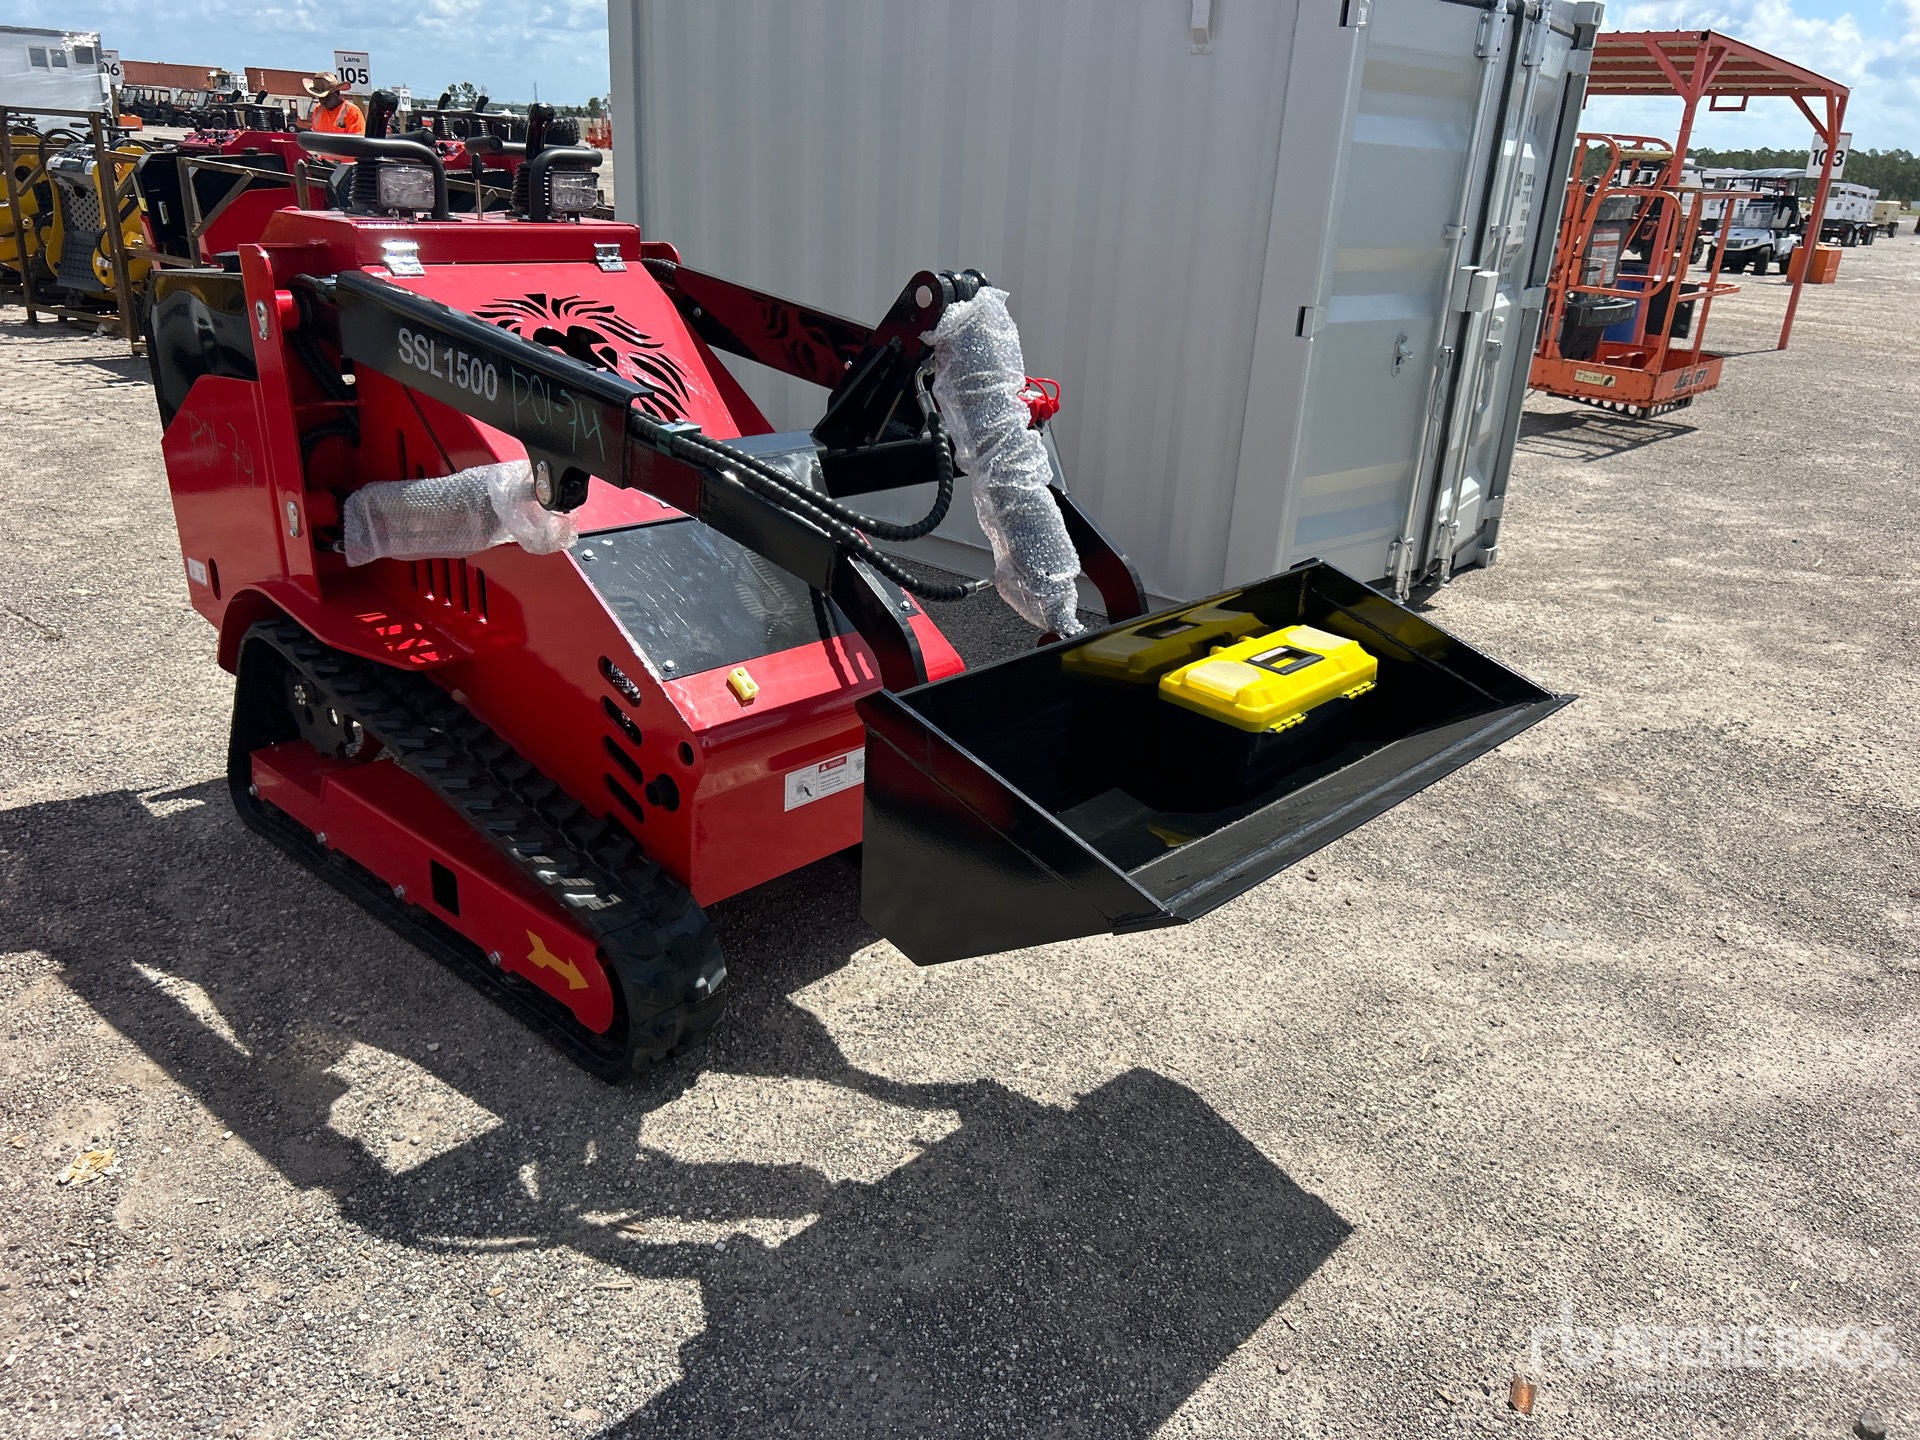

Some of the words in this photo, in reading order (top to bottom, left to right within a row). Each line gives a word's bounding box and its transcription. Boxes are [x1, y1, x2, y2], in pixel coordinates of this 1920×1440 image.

[338, 67, 369, 85] 105
[401, 96, 411, 106] 107
[398, 327, 498, 402] SSL1500
